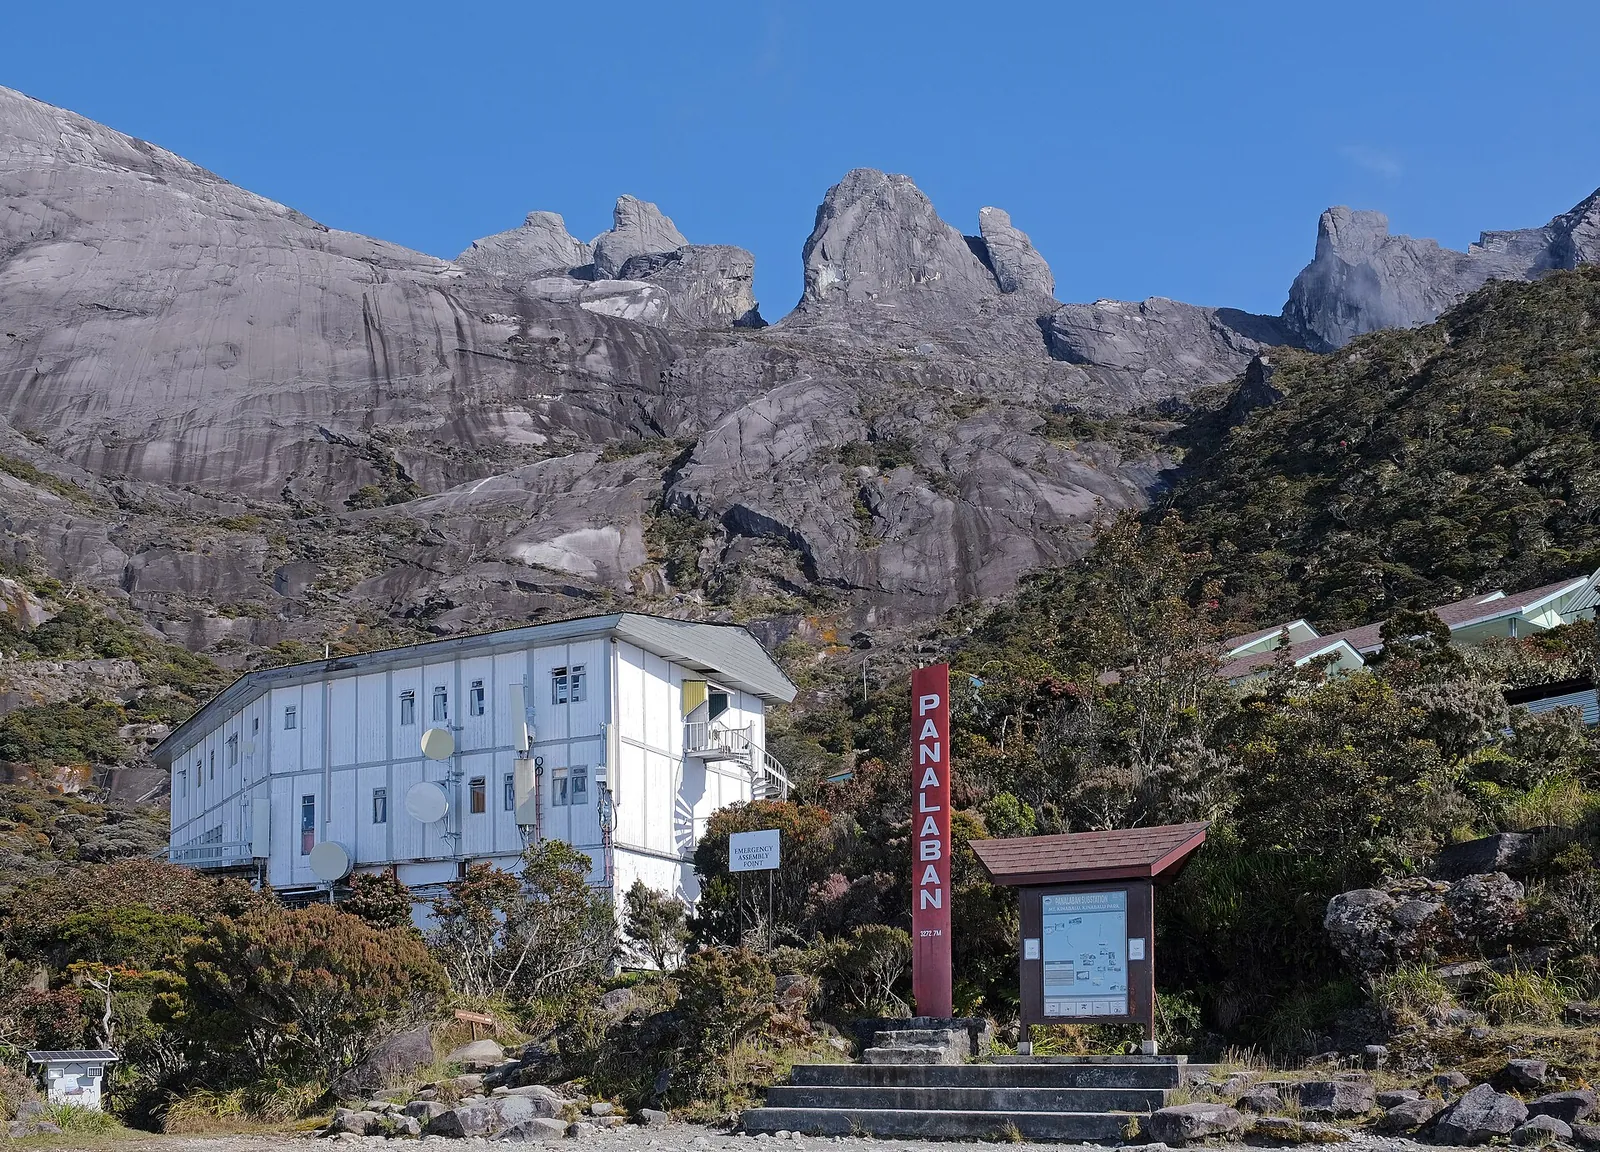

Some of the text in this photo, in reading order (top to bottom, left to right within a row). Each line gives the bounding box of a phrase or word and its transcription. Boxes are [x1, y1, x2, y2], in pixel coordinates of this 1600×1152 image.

[919, 693, 942, 910] PANALABAN
[734, 845, 774, 854] EMERGENCY
[738, 853, 769, 861] ASSEMBLY
